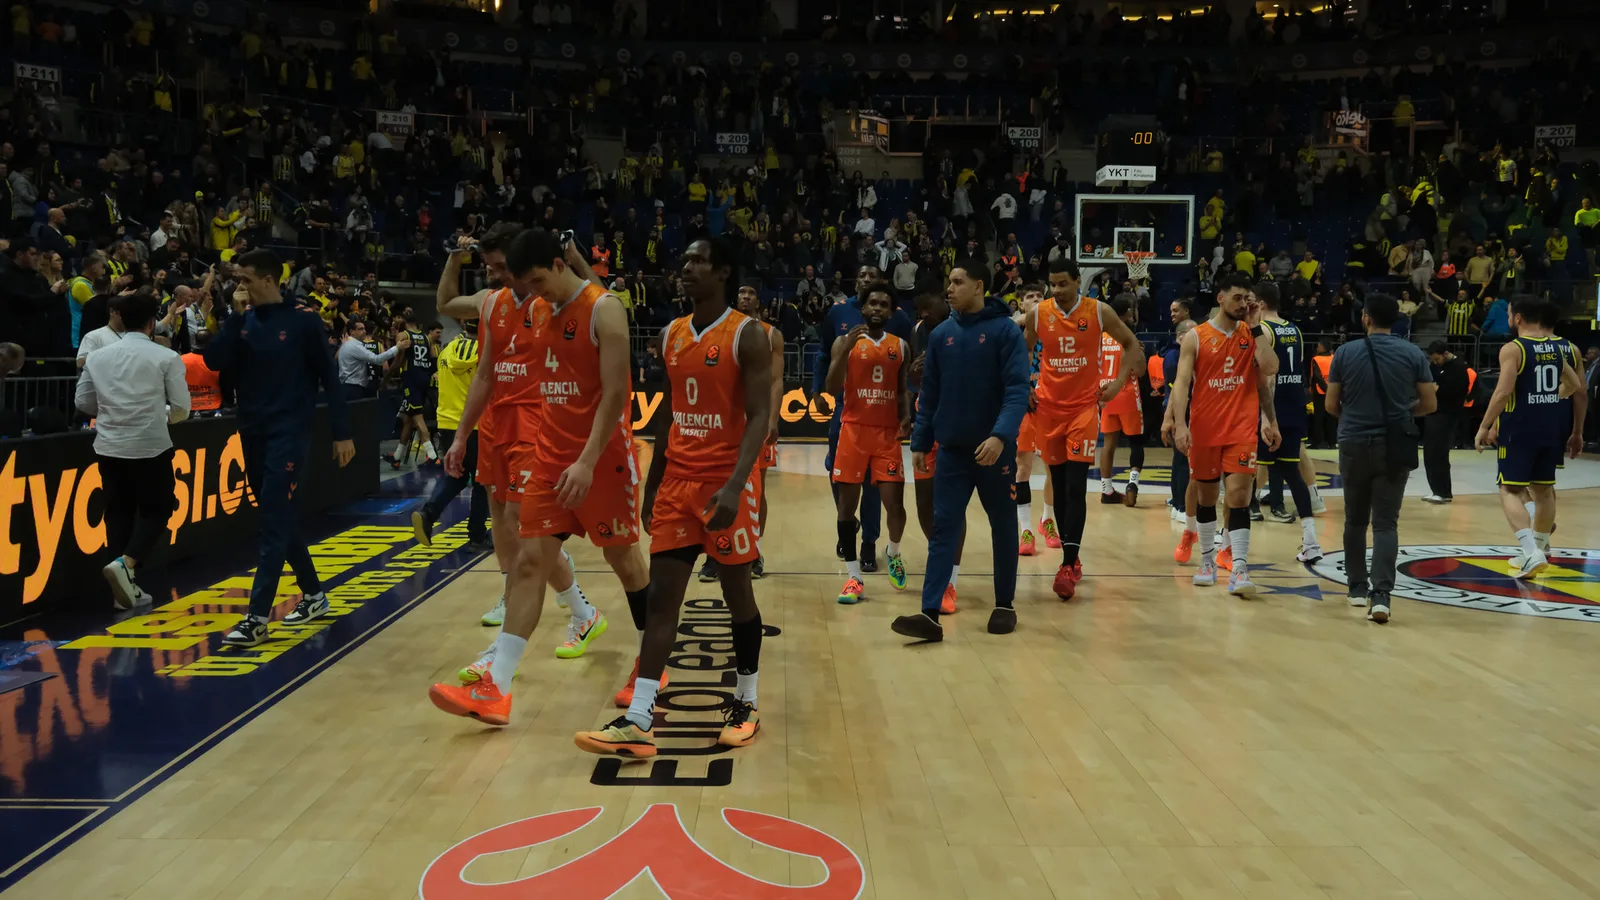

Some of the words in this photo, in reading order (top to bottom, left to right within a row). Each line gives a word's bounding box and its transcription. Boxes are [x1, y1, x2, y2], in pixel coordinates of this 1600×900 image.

[31, 67, 54, 80] 211
[728, 134, 748, 143] 209
[1019, 129, 1039, 137] 208
[1549, 127, 1573, 136] 207
[728, 145, 748, 154] 109
[1020, 139, 1039, 148] 108
[1108, 168, 1129, 177] YKT
[413, 344, 428, 362] 92
[1057, 336, 1076, 353] 12
[544, 346, 559, 373] 4
[1048, 357, 1088, 368] VALENCIA
[1104, 354, 1115, 377] 7
[1223, 356, 1235, 374] 2
[1286, 346, 1294, 373] 1
[494, 362, 528, 377] ALENCIA
[872, 365, 883, 383] 8
[1534, 363, 1559, 393] 10
[685, 377, 699, 405] 0
[857, 388, 896, 399] VALENCIA
[1527, 392, 1560, 404] İSTANBU
[672, 411, 723, 430] VALENCIA
[1083, 439, 1096, 456] 12
[1248, 451, 1257, 469] 2
[612, 517, 630, 538] 4
[733, 527, 750, 555] 0
